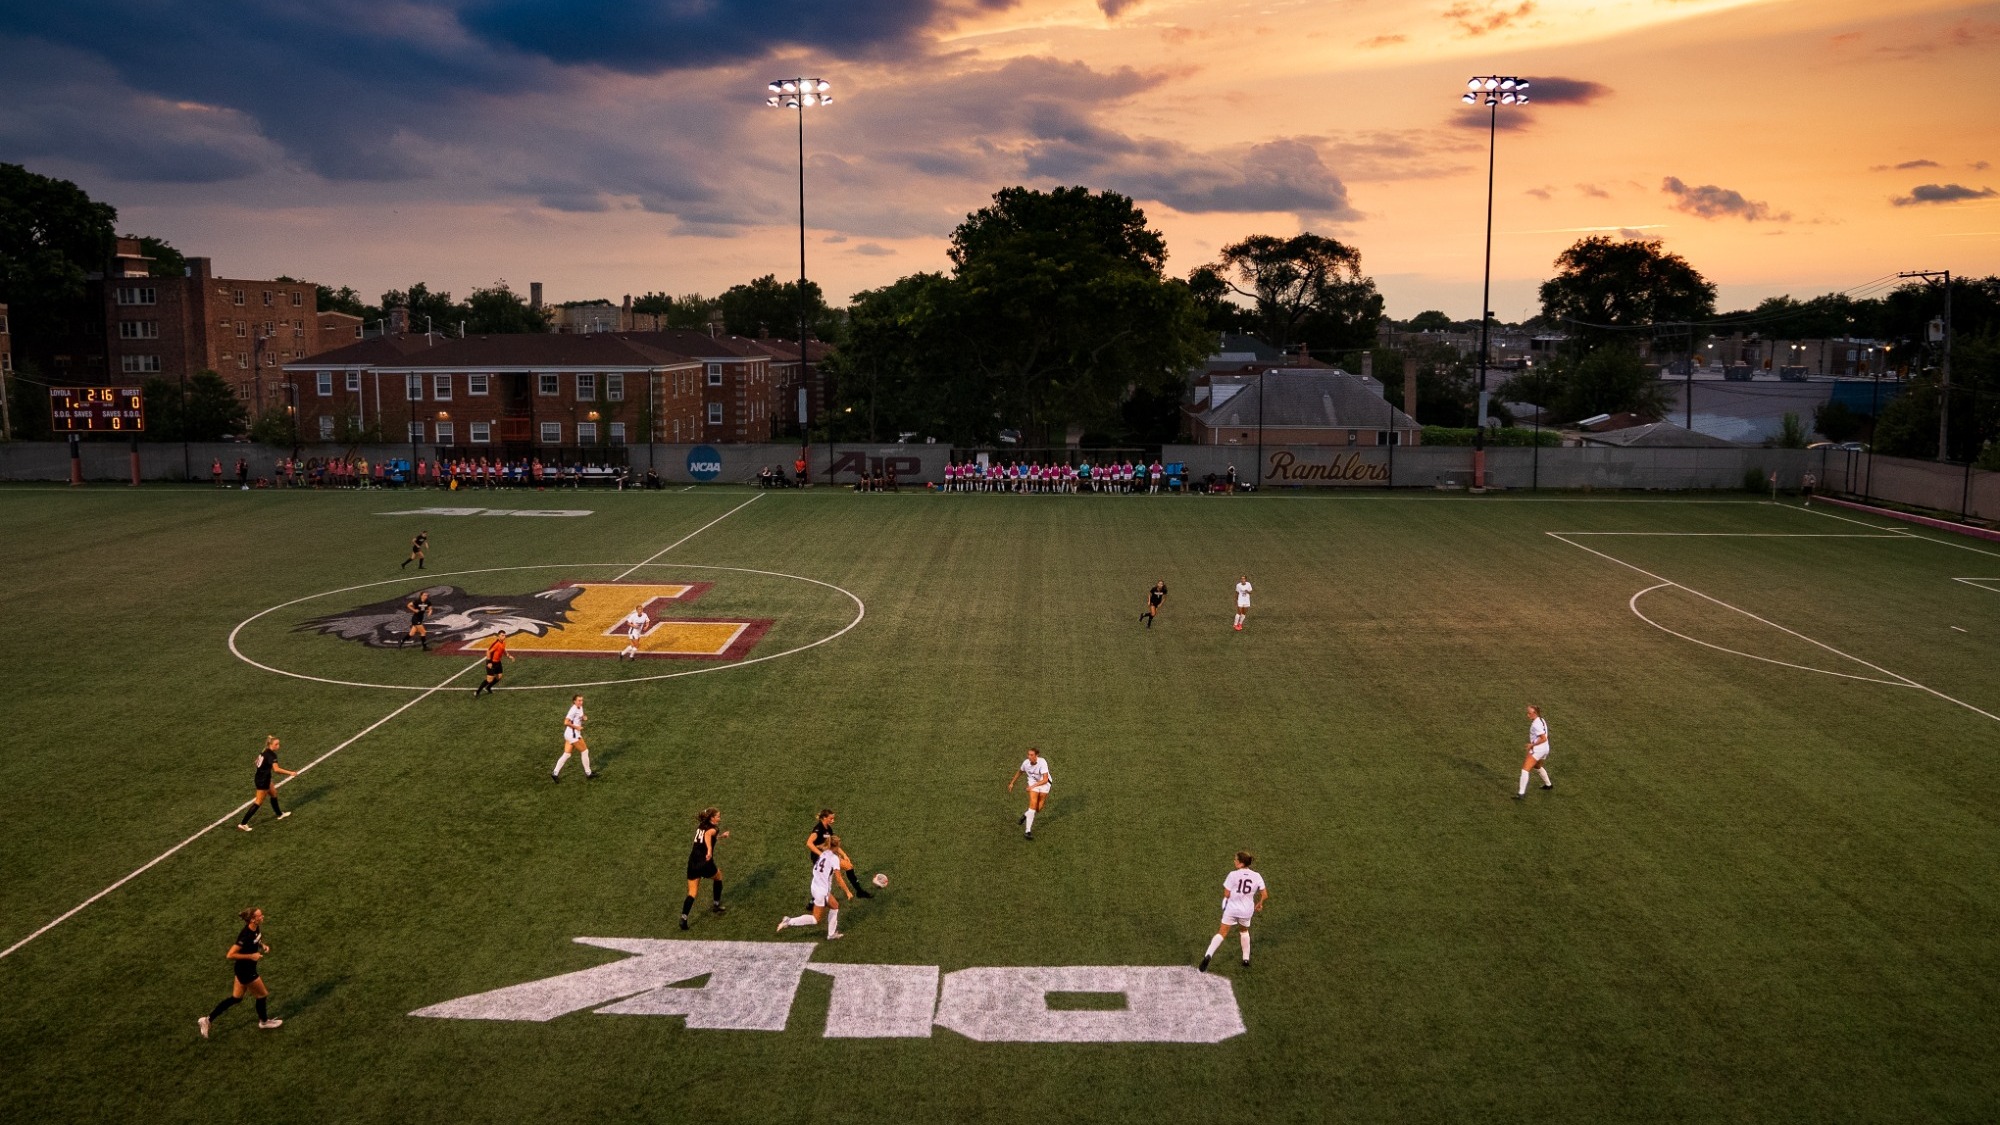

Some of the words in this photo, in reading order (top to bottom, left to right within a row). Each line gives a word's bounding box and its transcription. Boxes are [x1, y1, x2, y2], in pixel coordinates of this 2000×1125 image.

[50, 389, 72, 397] LOYOLA
[66, 397, 70, 408] 1
[131, 396, 140, 409] 0
[74, 410, 93, 418] SAVES
[102, 410, 121, 418] SAVES
[68, 418, 72, 429] 1
[88, 418, 92, 429] 1
[112, 417, 121, 430] 0
[137, 418, 141, 429] 1
[690, 462, 721, 472] NCAA
[821, 451, 922, 475] A10
[1264, 451, 1391, 481] Ramblers
[1236, 878, 1253, 895] 16
[409, 937, 1246, 1043] A10
